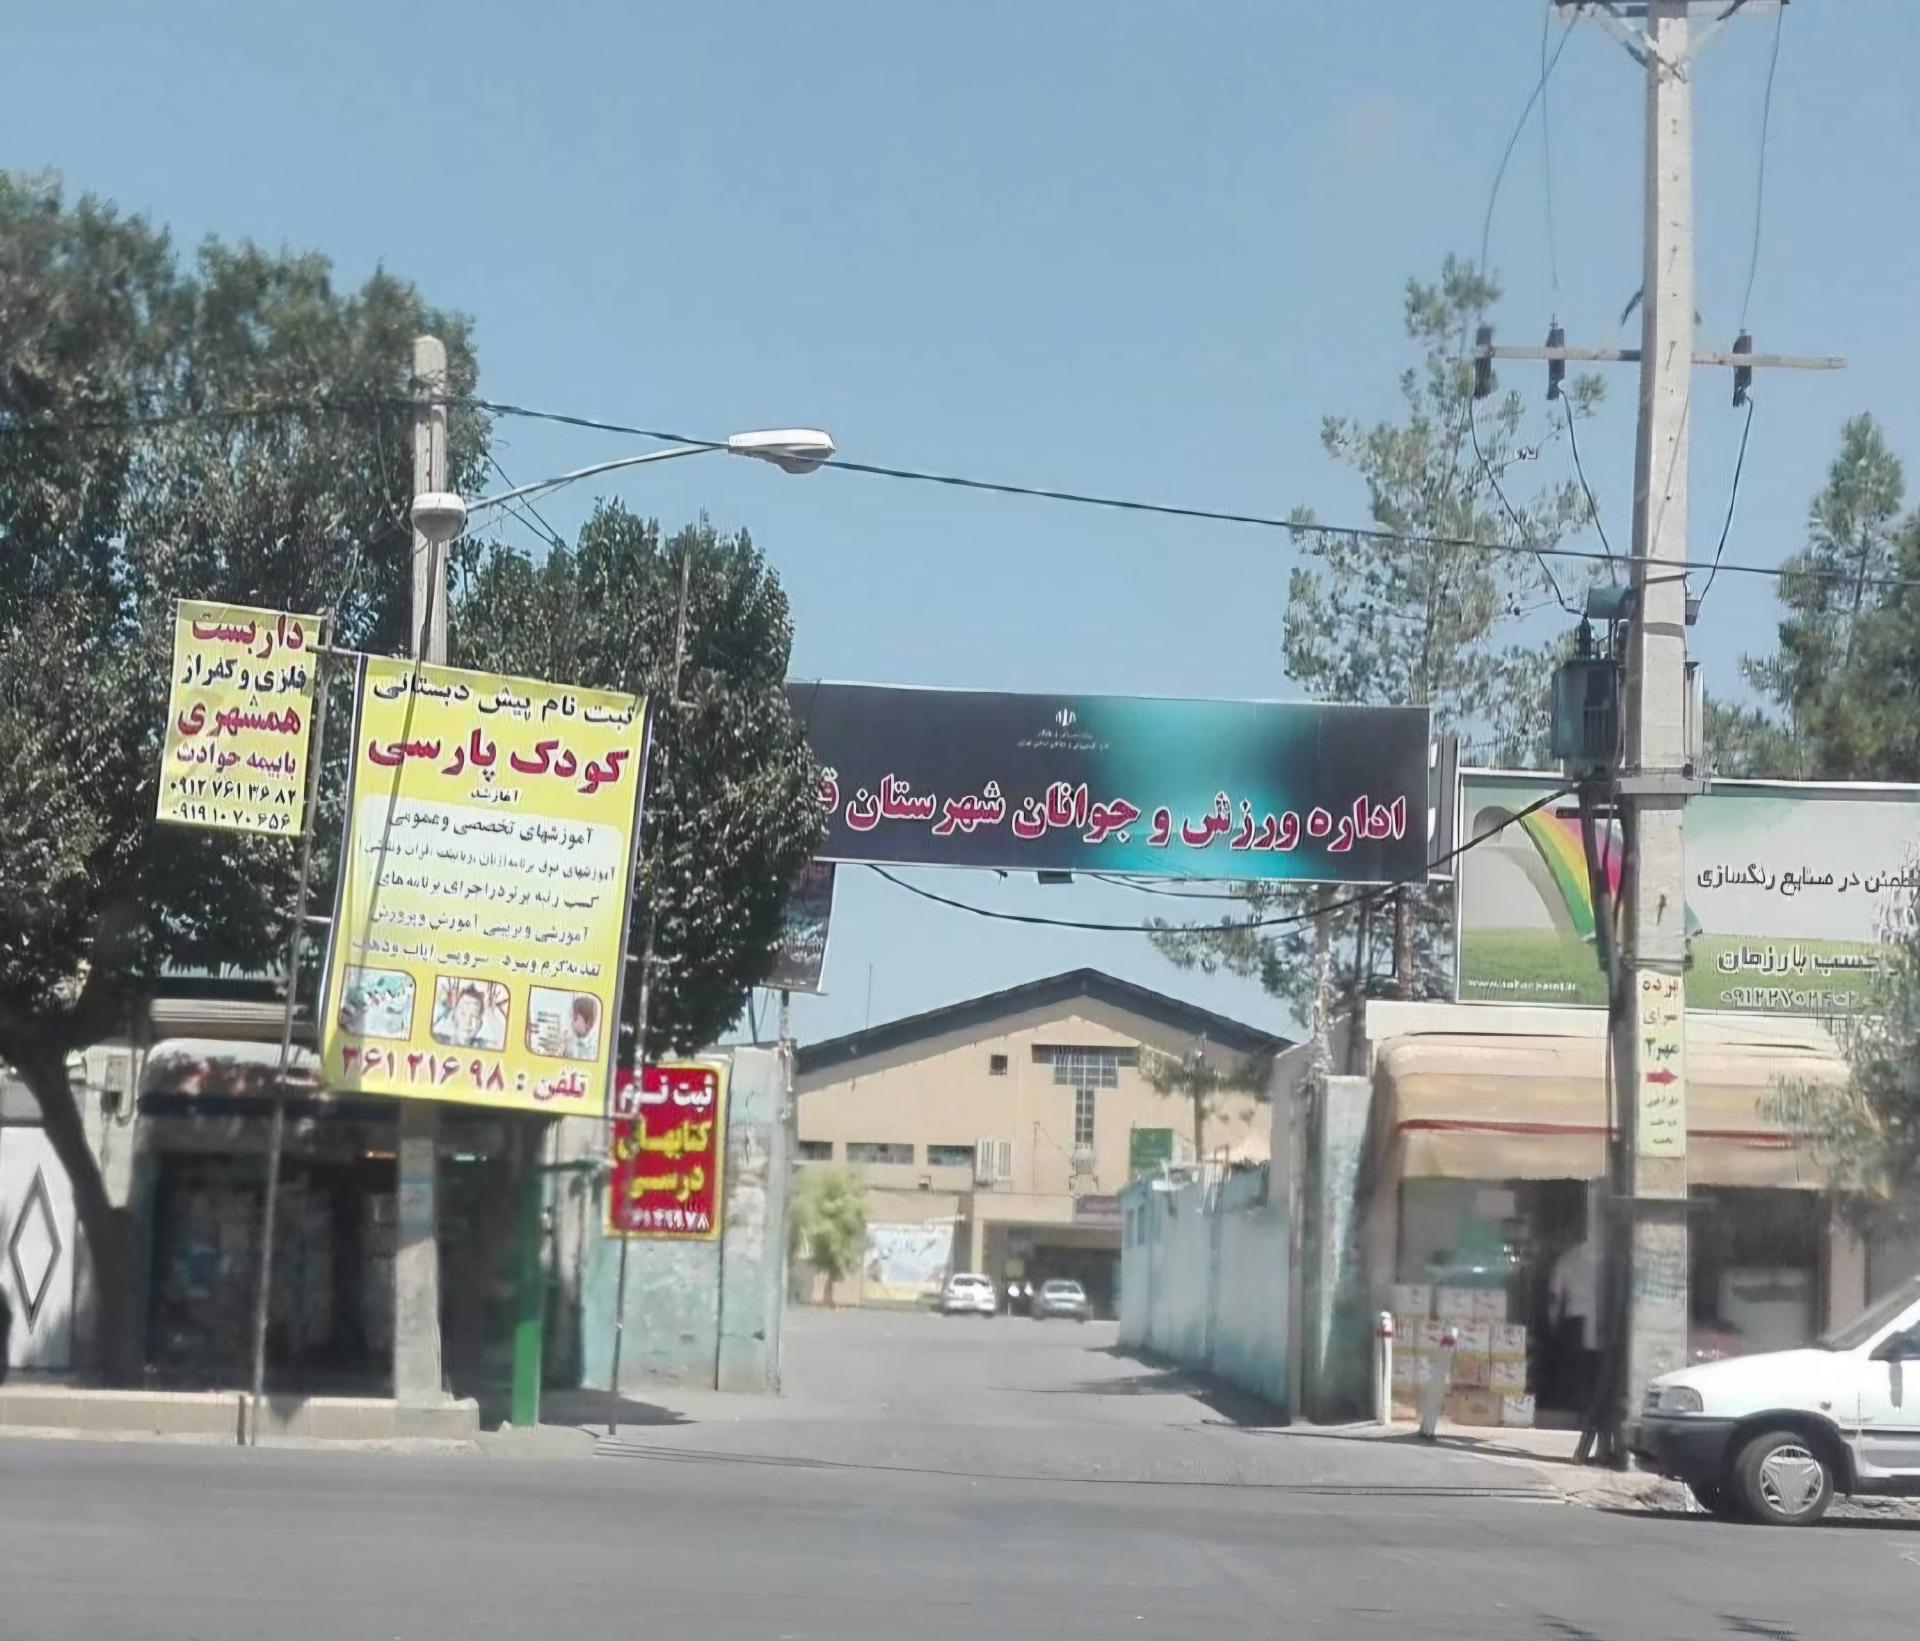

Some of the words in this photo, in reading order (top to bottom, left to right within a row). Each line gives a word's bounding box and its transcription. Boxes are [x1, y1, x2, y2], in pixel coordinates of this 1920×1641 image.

[238, 668, 250, 690] و
[255, 664, 307, 692] فلزی
[373, 671, 470, 706] دبستانی
[178, 695, 301, 737] همشهری
[478, 688, 531, 720] پیش
[541, 695, 576, 722] نام
[584, 704, 635, 730] ثبت
[177, 742, 241, 773] حوادث
[368, 727, 497, 783] پارسی
[510, 740, 630, 793] کودک
[846, 772, 1006, 836] شهرستان
[1011, 782, 1141, 844] جوانان
[389, 812, 440, 829] عمومی
[453, 818, 515, 836] تخصصی
[520, 823, 594, 849] آموزشهای
[1148, 806, 1172, 846] و
[1180, 791, 1300, 851] ورزش
[1307, 794, 1406, 852] اداره
[1697, 863, 1776, 890] رنگسازی
[1779, 865, 1834, 896] صنایع
[1838, 871, 1860, 892] در
[533, 1066, 587, 1100] تلفن
[673, 1073, 713, 1112] ثبت
